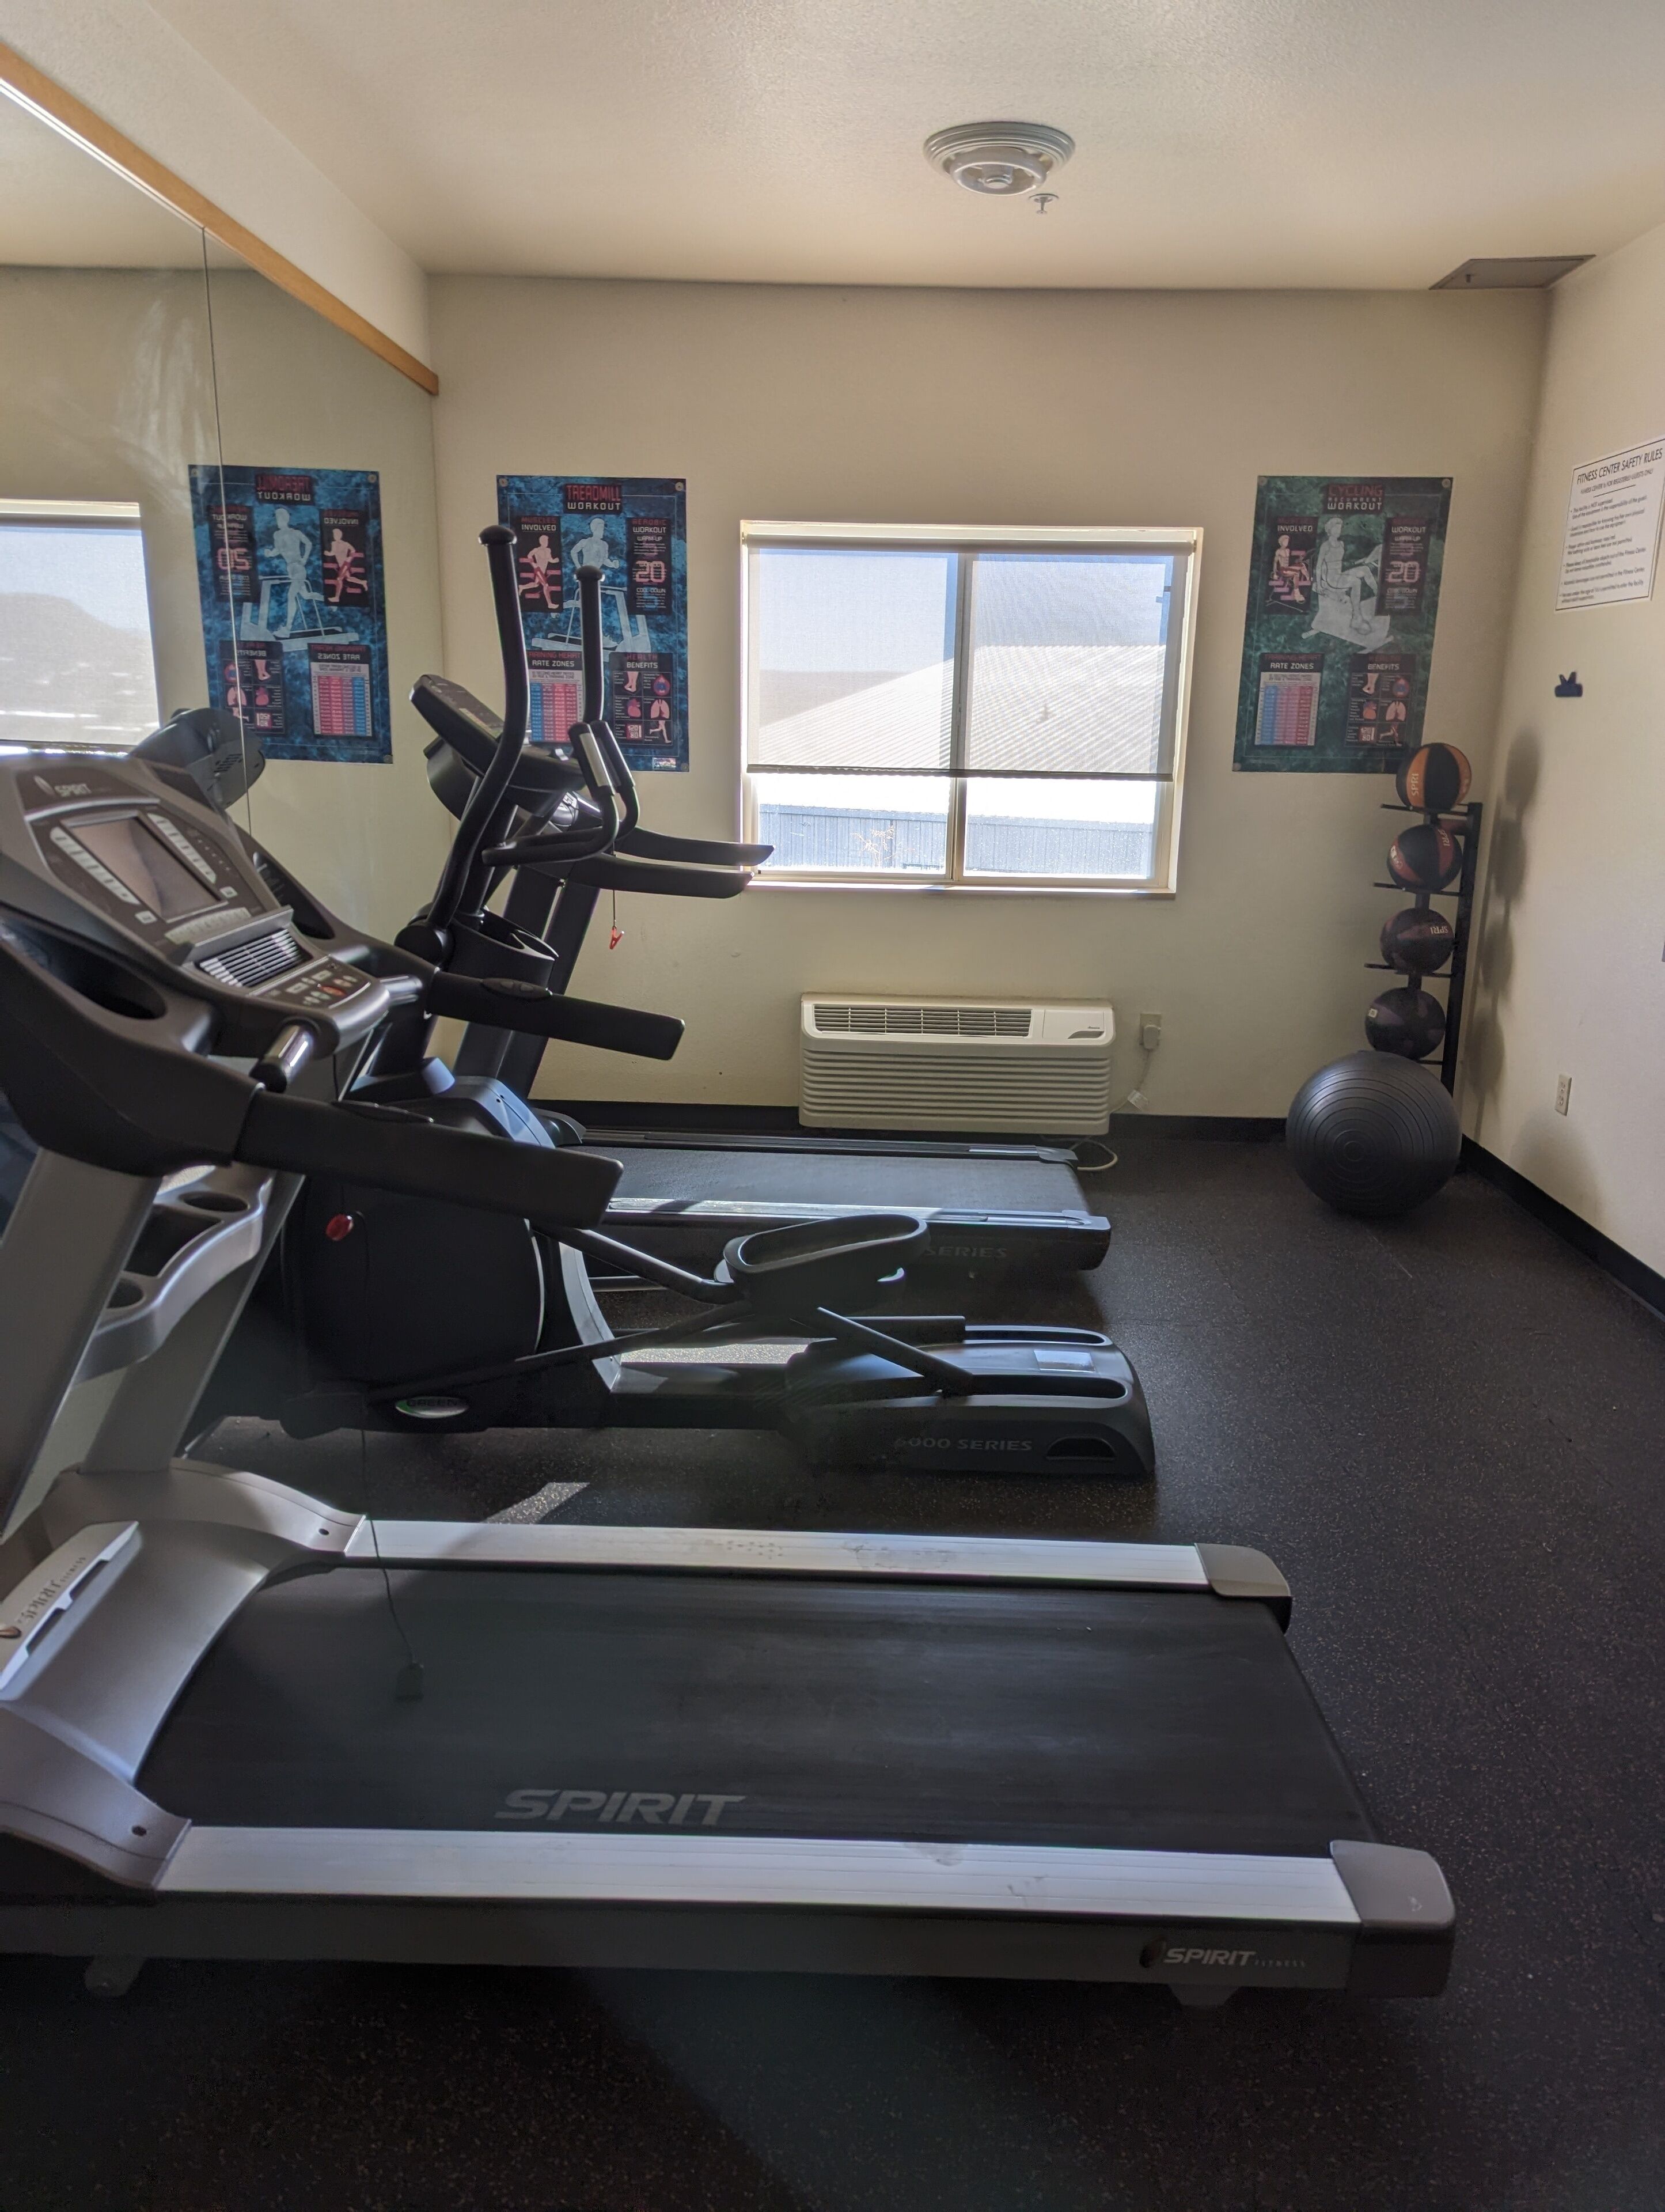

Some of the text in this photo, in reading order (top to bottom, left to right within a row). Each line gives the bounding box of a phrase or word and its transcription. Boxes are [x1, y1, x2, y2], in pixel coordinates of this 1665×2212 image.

[1577, 448, 1663, 484] FITNESS CENTER SAFETY RULES
[567, 485, 621, 501] TREADMILL
[1329, 484, 1383, 498] CYCLING
[567, 502, 621, 510] WORKOUT
[1327, 502, 1382, 510] WORKOUT
[635, 560, 665, 583] 20
[1389, 560, 1420, 583] 20
[1410, 772, 1420, 797] SPRI
[924, 1246, 1007, 1259] SERIES
[957, 1438, 1033, 1452] SERIES
[495, 1789, 747, 1827] SPIRIT
[1163, 1948, 1257, 1967] SPIRIT
